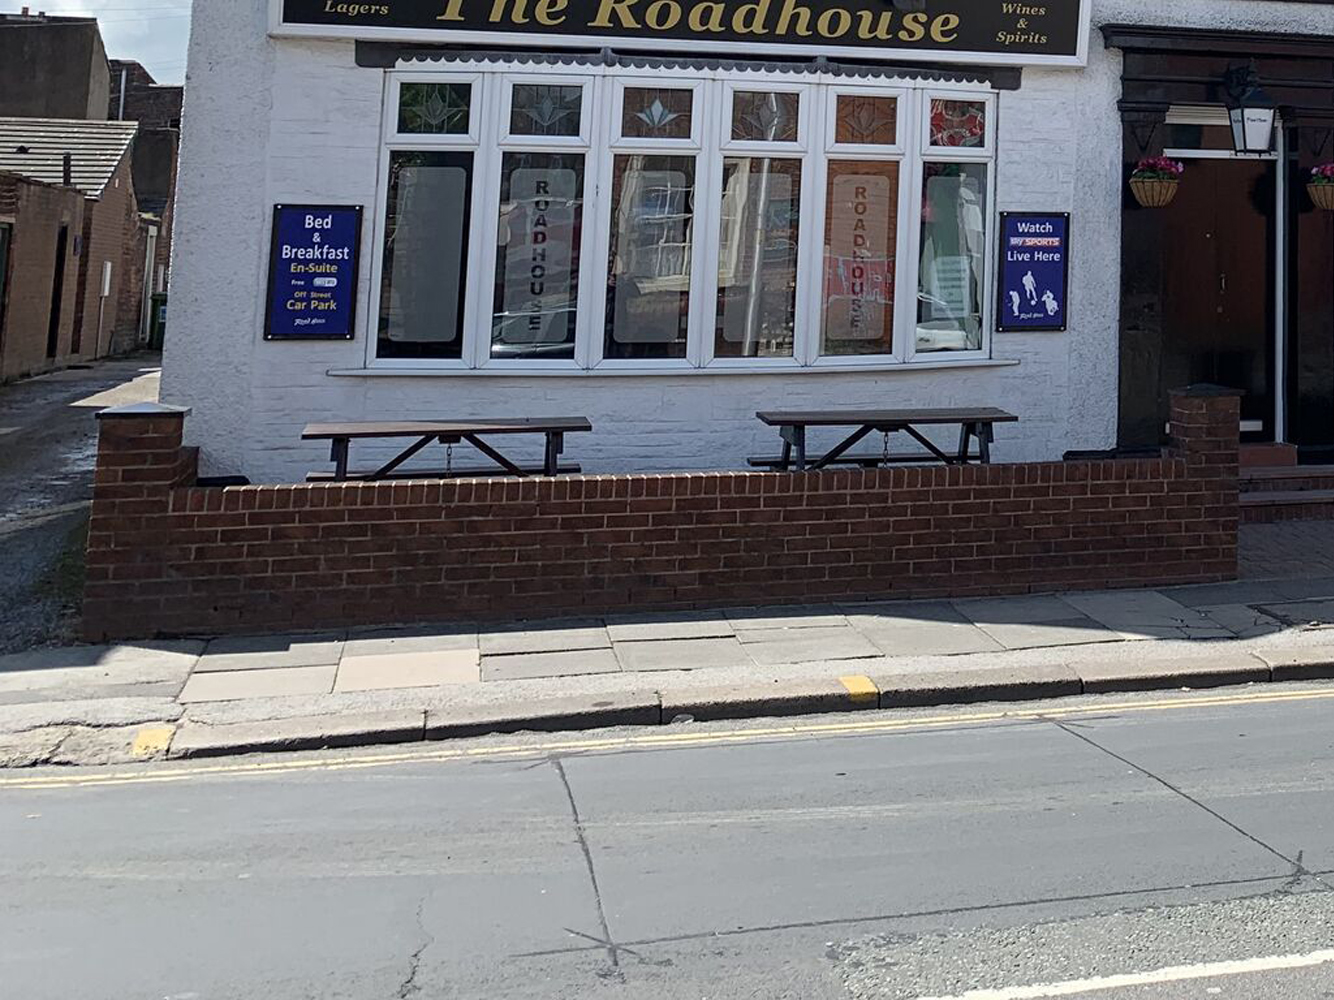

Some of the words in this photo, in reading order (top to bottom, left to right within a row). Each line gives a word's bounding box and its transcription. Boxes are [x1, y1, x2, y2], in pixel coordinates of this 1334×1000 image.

[324, 0, 389, 16] Lagers
[1001, 2, 1047, 16] Wines
[1017, 18, 1029, 29] &
[996, 30, 1048, 46] Spirits
[305, 215, 332, 229] Bed
[1017, 222, 1053, 233] Watch
[312, 232, 321, 243] &
[282, 245, 349, 260] Breakfast
[1007, 251, 1030, 261] Live
[1034, 251, 1060, 261] Here
[290, 263, 338, 273] En-Suite
[287, 300, 307, 310] Car
[311, 300, 337, 310] Park
